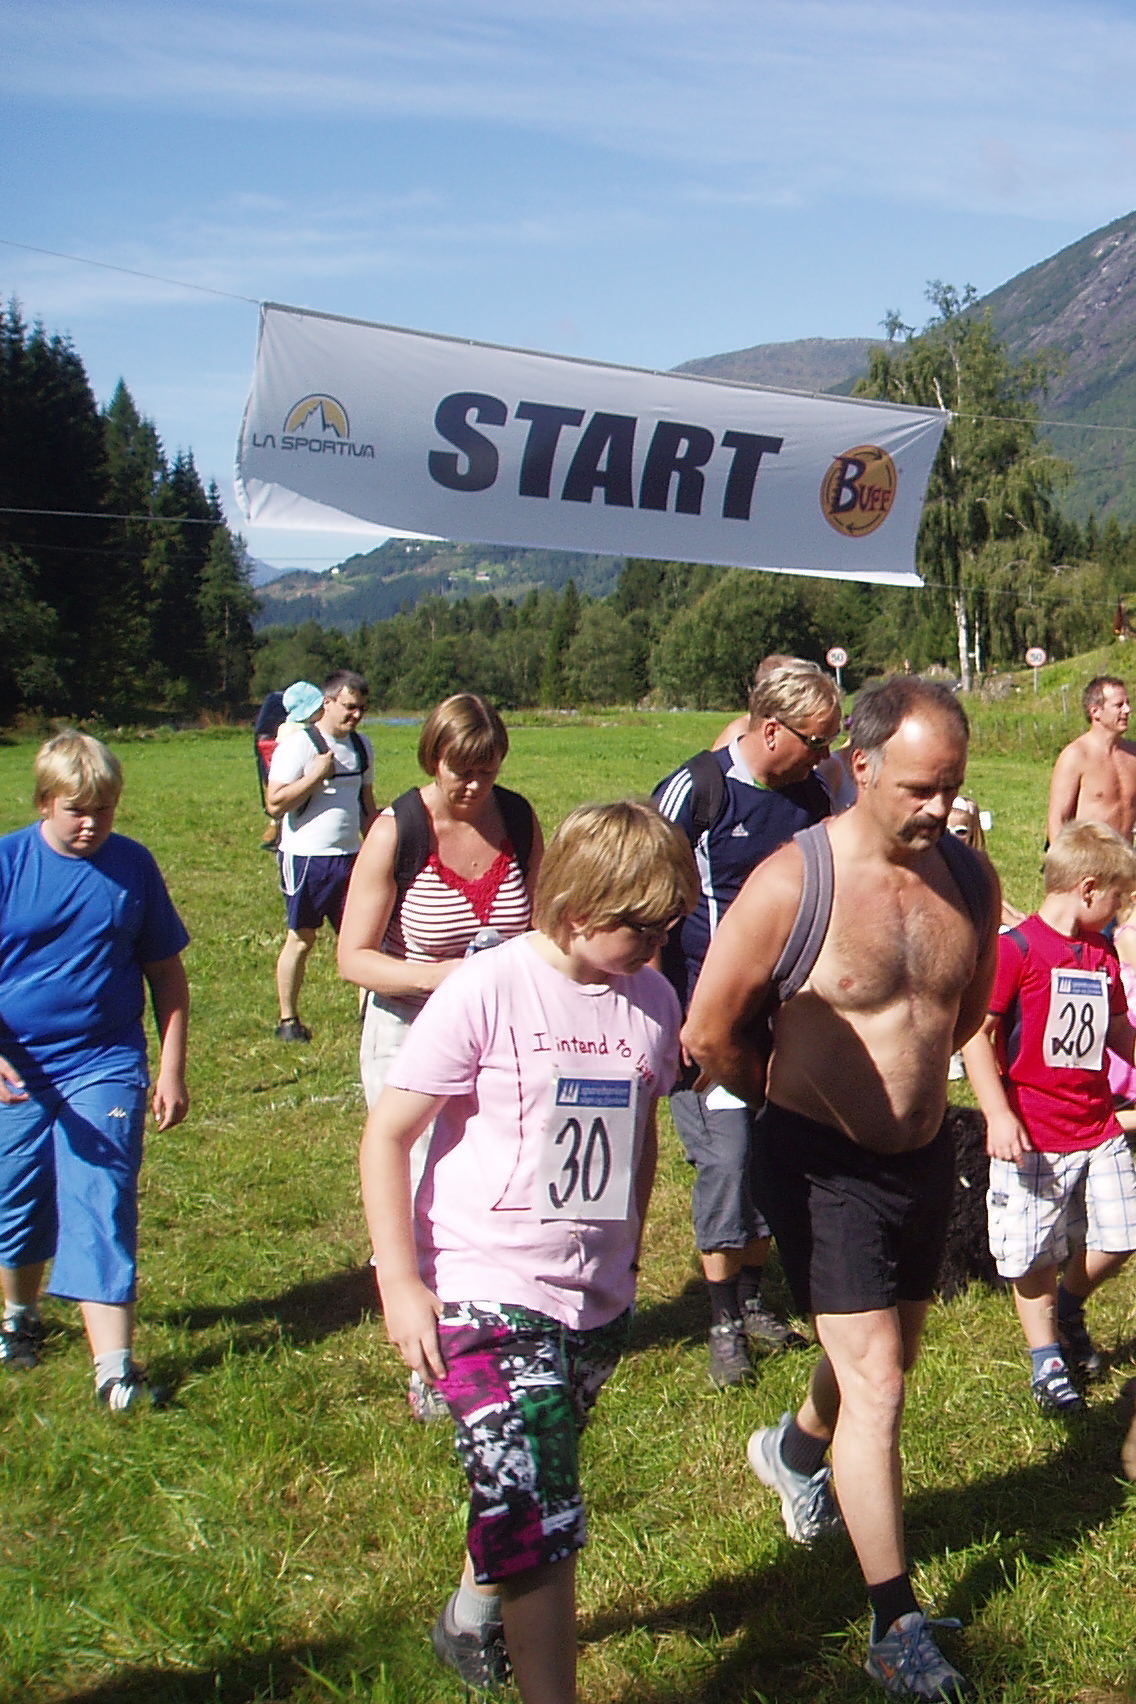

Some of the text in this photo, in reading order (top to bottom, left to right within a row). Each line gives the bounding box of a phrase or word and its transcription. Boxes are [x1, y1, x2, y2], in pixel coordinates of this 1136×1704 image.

[252, 432, 375, 459] LA SPORTIVA
[428, 391, 784, 521] START
[533, 1032, 552, 1052] I
[556, 1033, 609, 1055] intend
[1051, 1001, 1095, 1058] 28
[548, 1117, 611, 1209] 30
